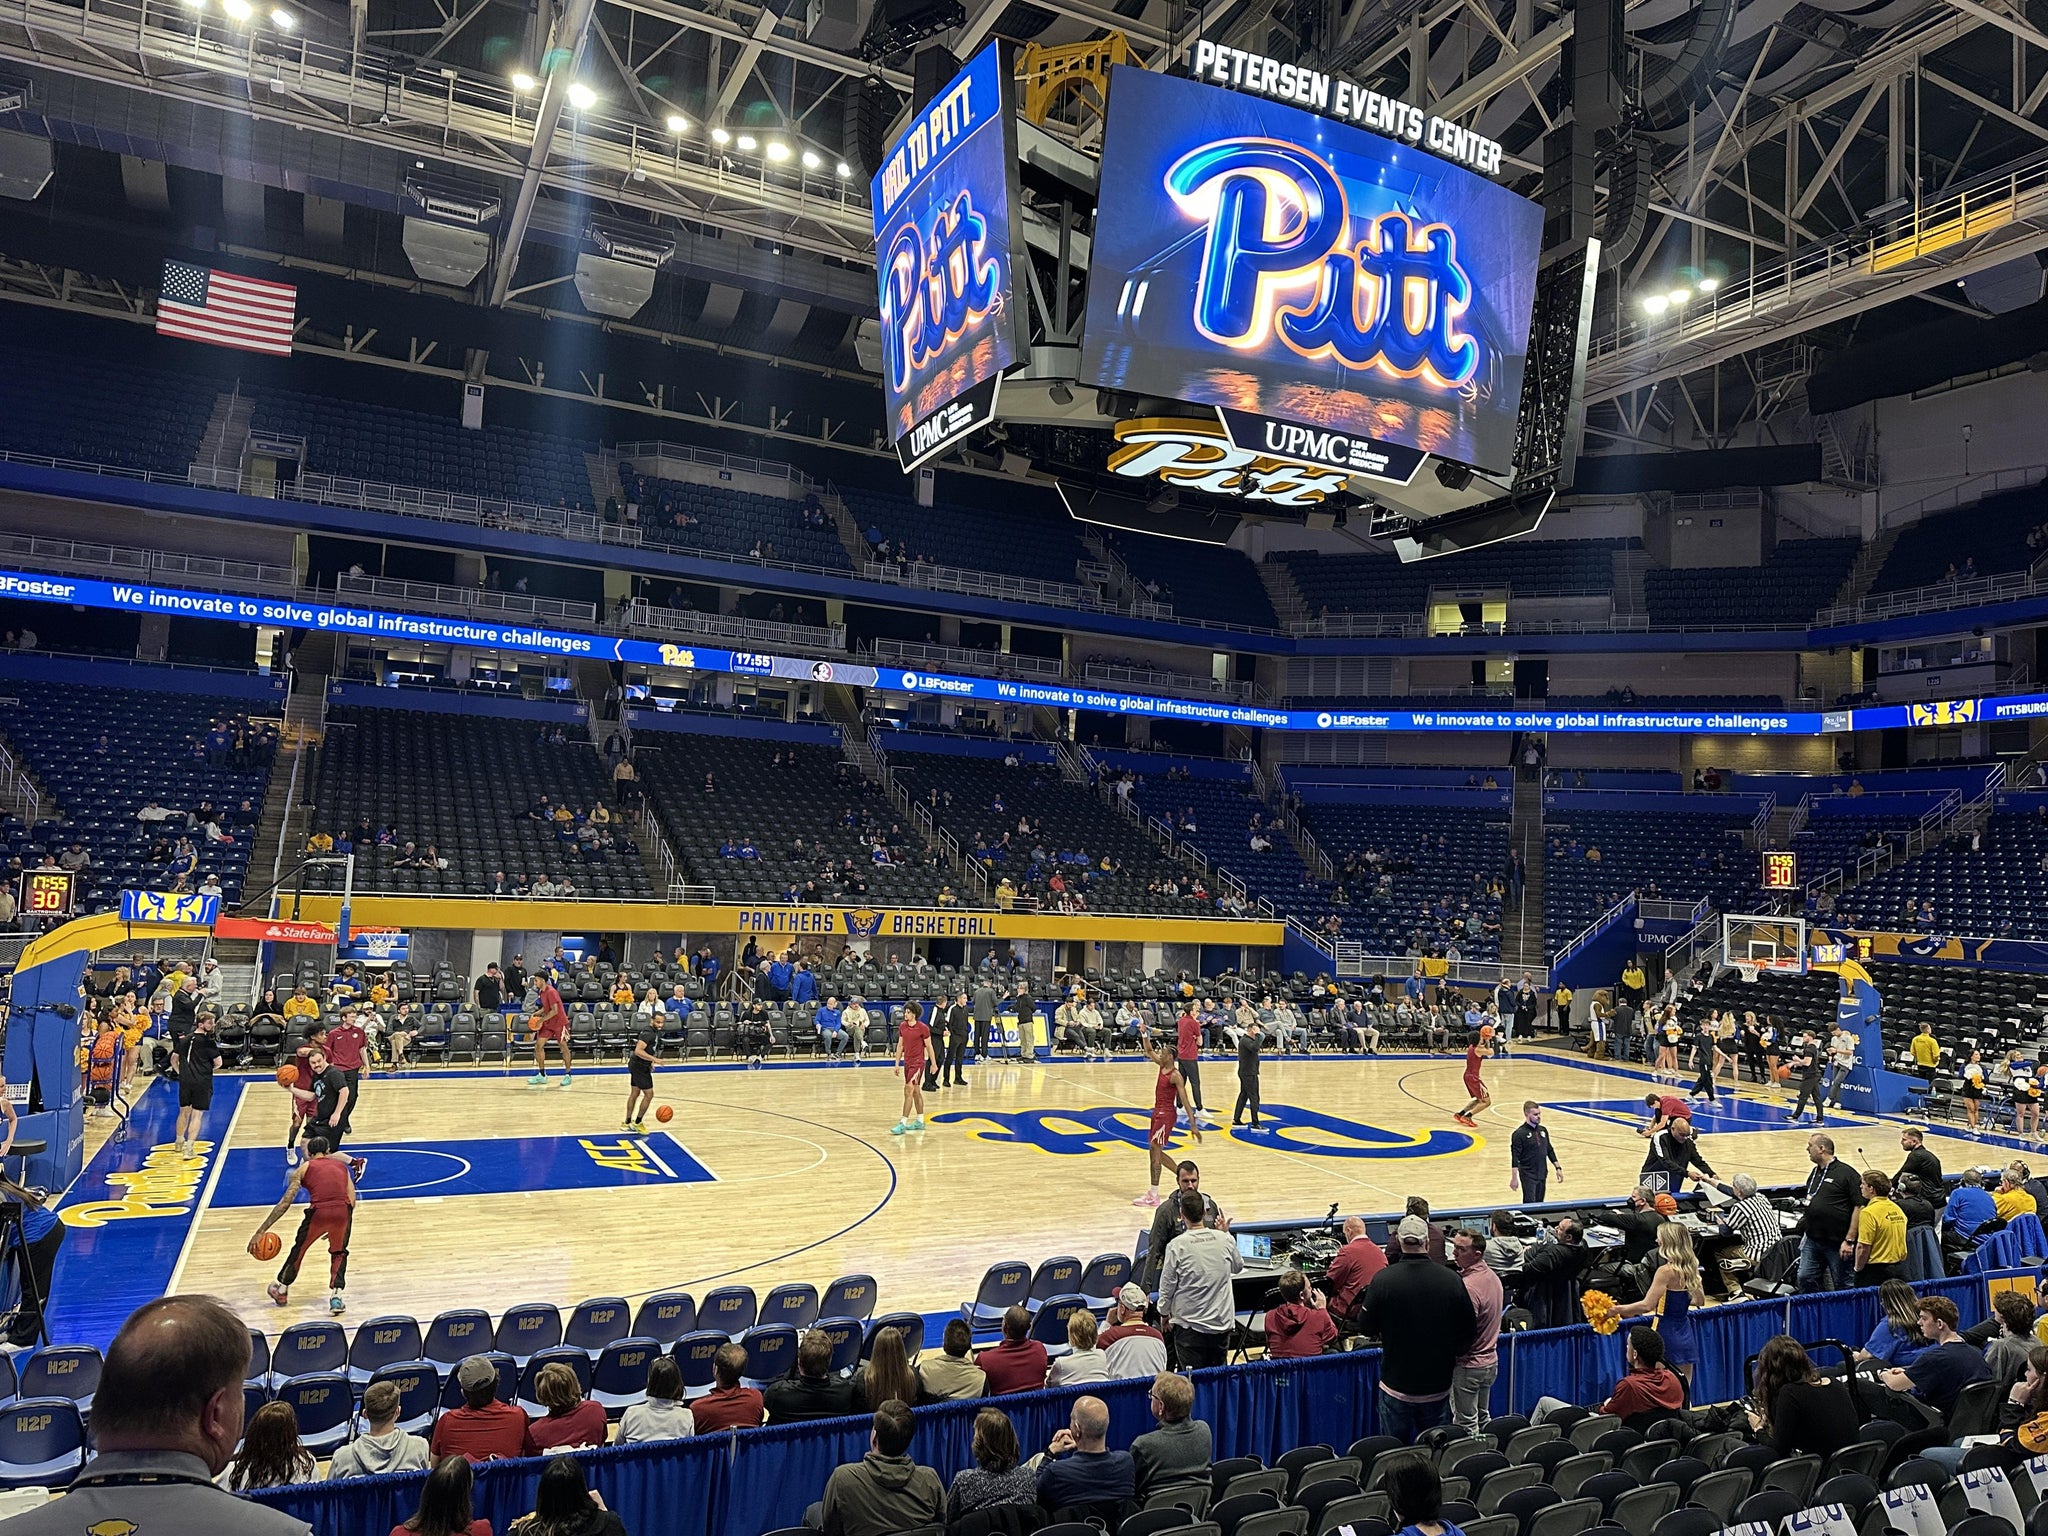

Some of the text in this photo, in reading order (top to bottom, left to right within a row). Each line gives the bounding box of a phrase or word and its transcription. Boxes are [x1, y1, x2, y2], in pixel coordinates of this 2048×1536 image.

[1196, 39, 1503, 176] PETERSEN EVENTS CENTER
[881, 74, 972, 215] HAIL TO PITT
[1164, 136, 1480, 389] Pitt
[879, 188, 1001, 394] Pitt
[909, 410, 949, 457] UPMC
[1265, 421, 1349, 463] UPMC
[1350, 439, 1369, 451] LIFE
[112, 586, 592, 653] We innovate to solve global infrastructure challenges
[658, 644, 695, 668] Pitt
[735, 652, 771, 667] 17:55
[918, 676, 975, 692] LBFoster
[997, 683, 1288, 726] We innovate to solve global infrastructure challenges
[1333, 715, 1390, 726] LBFoster
[1412, 713, 1788, 730] We innovate to solve global infrastructure challenges
[1769, 855, 1794, 867] 17:55
[33, 876, 68, 891] 17:55
[1770, 866, 1792, 885] 30
[33, 890, 60, 909] 30
[738, 911, 834, 931] PANTHERS
[892, 915, 996, 936] BASKETBALL
[1638, 933, 1674, 944] UPMC
[1832, 1081, 1872, 1094] earview
[577, 1138, 661, 1176] ACC
[1001, 1272, 1022, 1285] H2P
[1053, 1267, 1073, 1281] H2P
[1103, 1264, 1122, 1277] H2P
[843, 1286, 866, 1300] H2P
[719, 1298, 743, 1312] H2P
[782, 1295, 806, 1309] H2P
[590, 1310, 616, 1324] H2P
[657, 1305, 682, 1319] H2P
[448, 1322, 475, 1337] H2P
[518, 1316, 544, 1331] H2P
[297, 1334, 327, 1350] H2P
[374, 1329, 402, 1344] H2P
[690, 1345, 718, 1360] H2P
[759, 1337, 785, 1353] H2P
[47, 1359, 79, 1375] H2P
[618, 1351, 646, 1368] H2P
[299, 1388, 330, 1405] H2P
[16, 1415, 53, 1433] H2P
